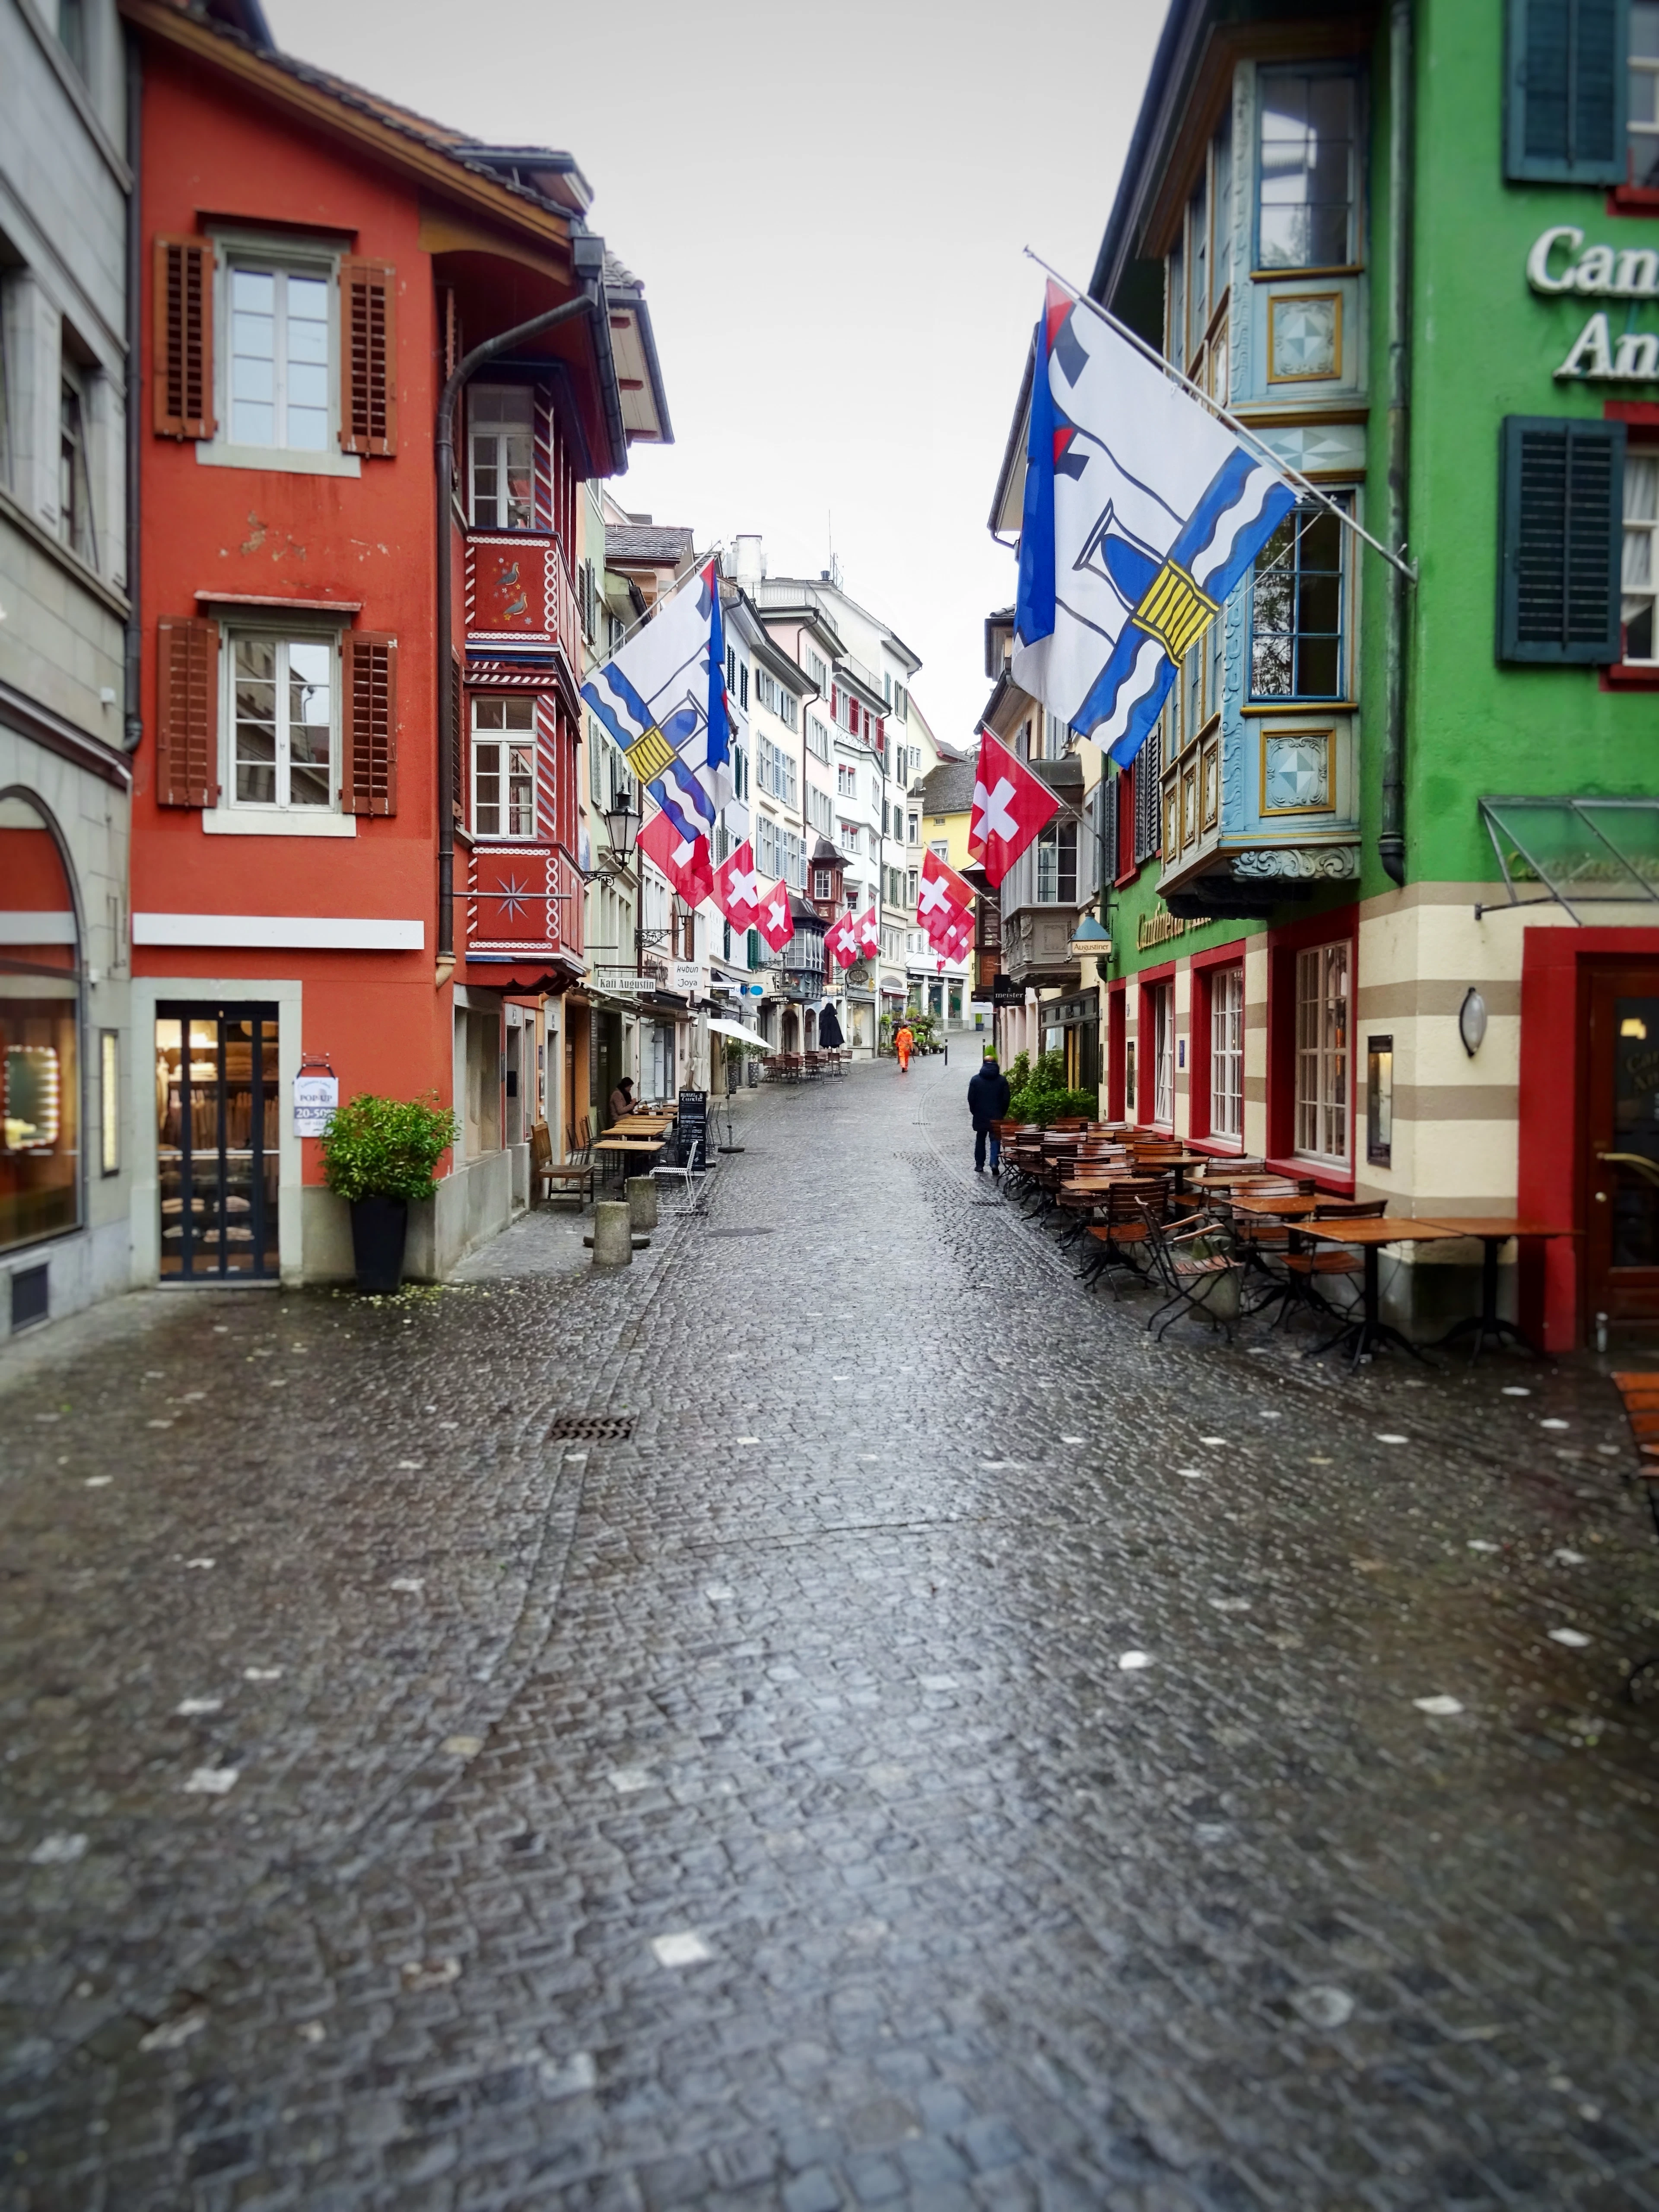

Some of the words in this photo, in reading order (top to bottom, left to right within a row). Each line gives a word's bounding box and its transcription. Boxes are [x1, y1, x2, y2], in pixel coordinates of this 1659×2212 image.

[1074, 943, 1109, 953] Augustiner
[600, 979, 617, 988] Kafi
[619, 979, 654, 989] Augustin
